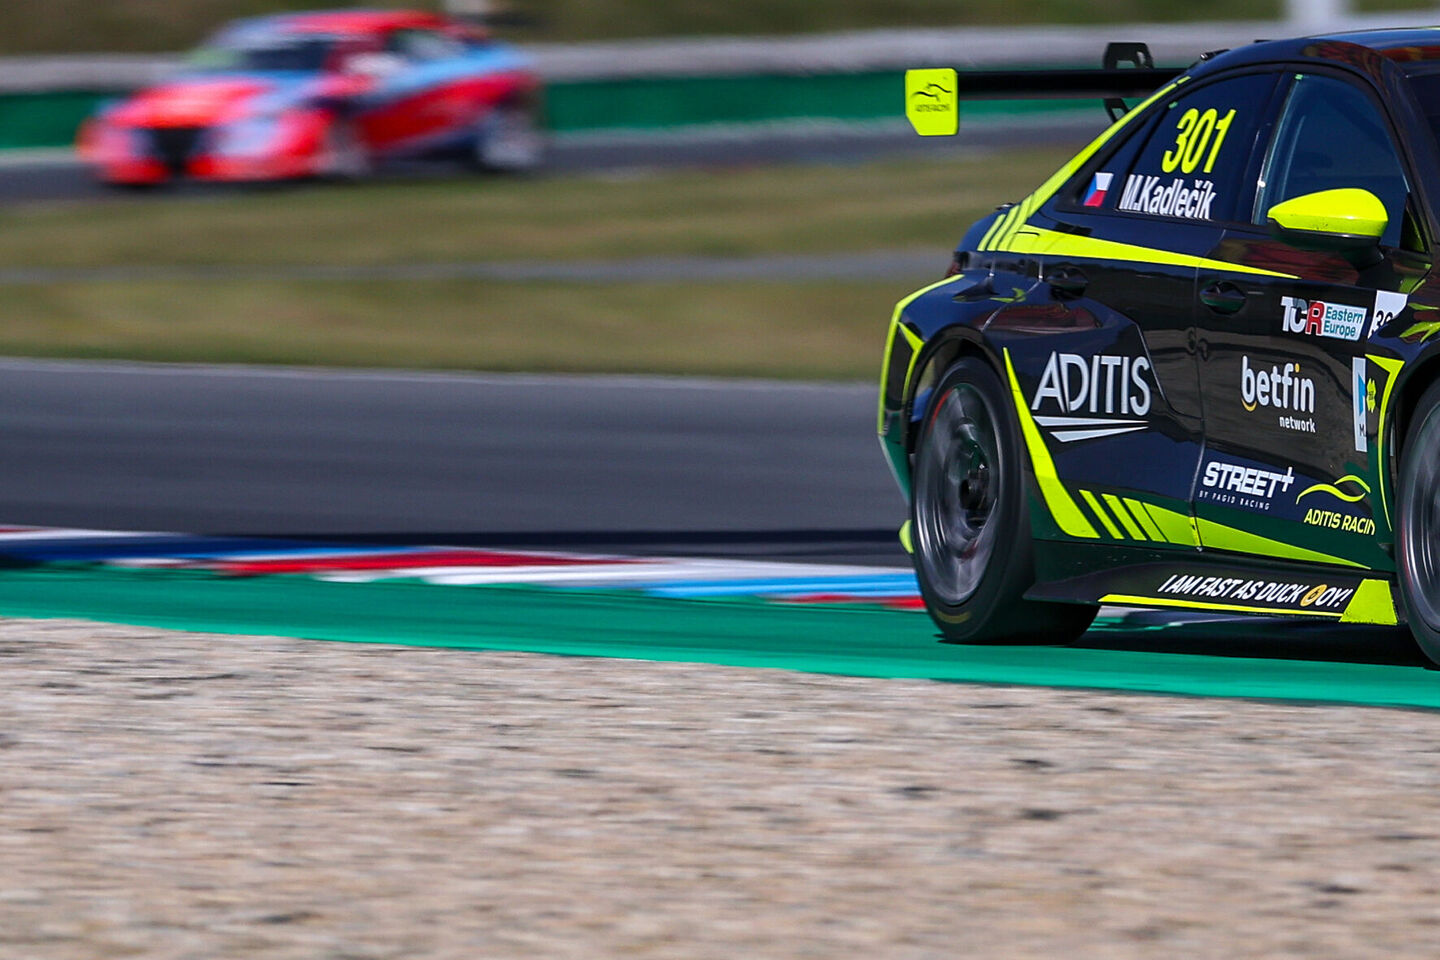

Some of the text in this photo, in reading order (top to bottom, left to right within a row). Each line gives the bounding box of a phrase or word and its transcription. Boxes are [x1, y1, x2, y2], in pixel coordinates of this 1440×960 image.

[1162, 108, 1236, 174] 301
[1326, 307, 1364, 324] Eastern
[1323, 320, 1357, 339] Europe
[1031, 351, 1151, 416] ADITIS
[1241, 355, 1315, 413] betfin
[1279, 416, 1316, 433] network
[1304, 508, 1341, 530] ADITIS
[1157, 574, 1178, 592] I
[1164, 575, 1203, 595] AM
[1192, 577, 1243, 598] FAST
[1229, 580, 1264, 600] AS
[1254, 582, 1310, 603] DUCK
